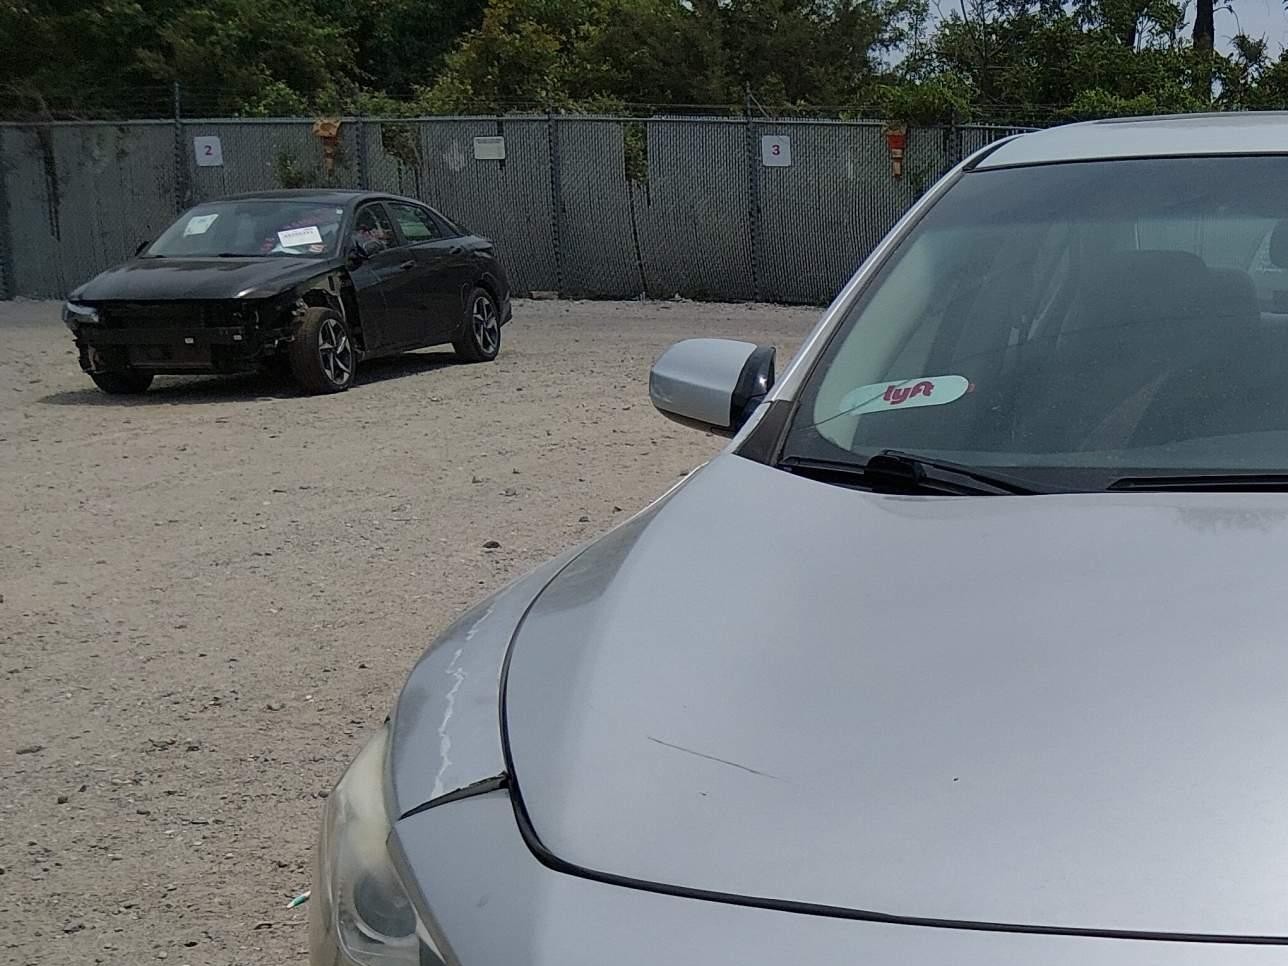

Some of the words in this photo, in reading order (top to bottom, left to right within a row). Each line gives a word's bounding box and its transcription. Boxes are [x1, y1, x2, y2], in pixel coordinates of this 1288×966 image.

[204, 145, 213, 156] 2
[772, 144, 780, 156] 3
[883, 381, 935, 404] lyft
